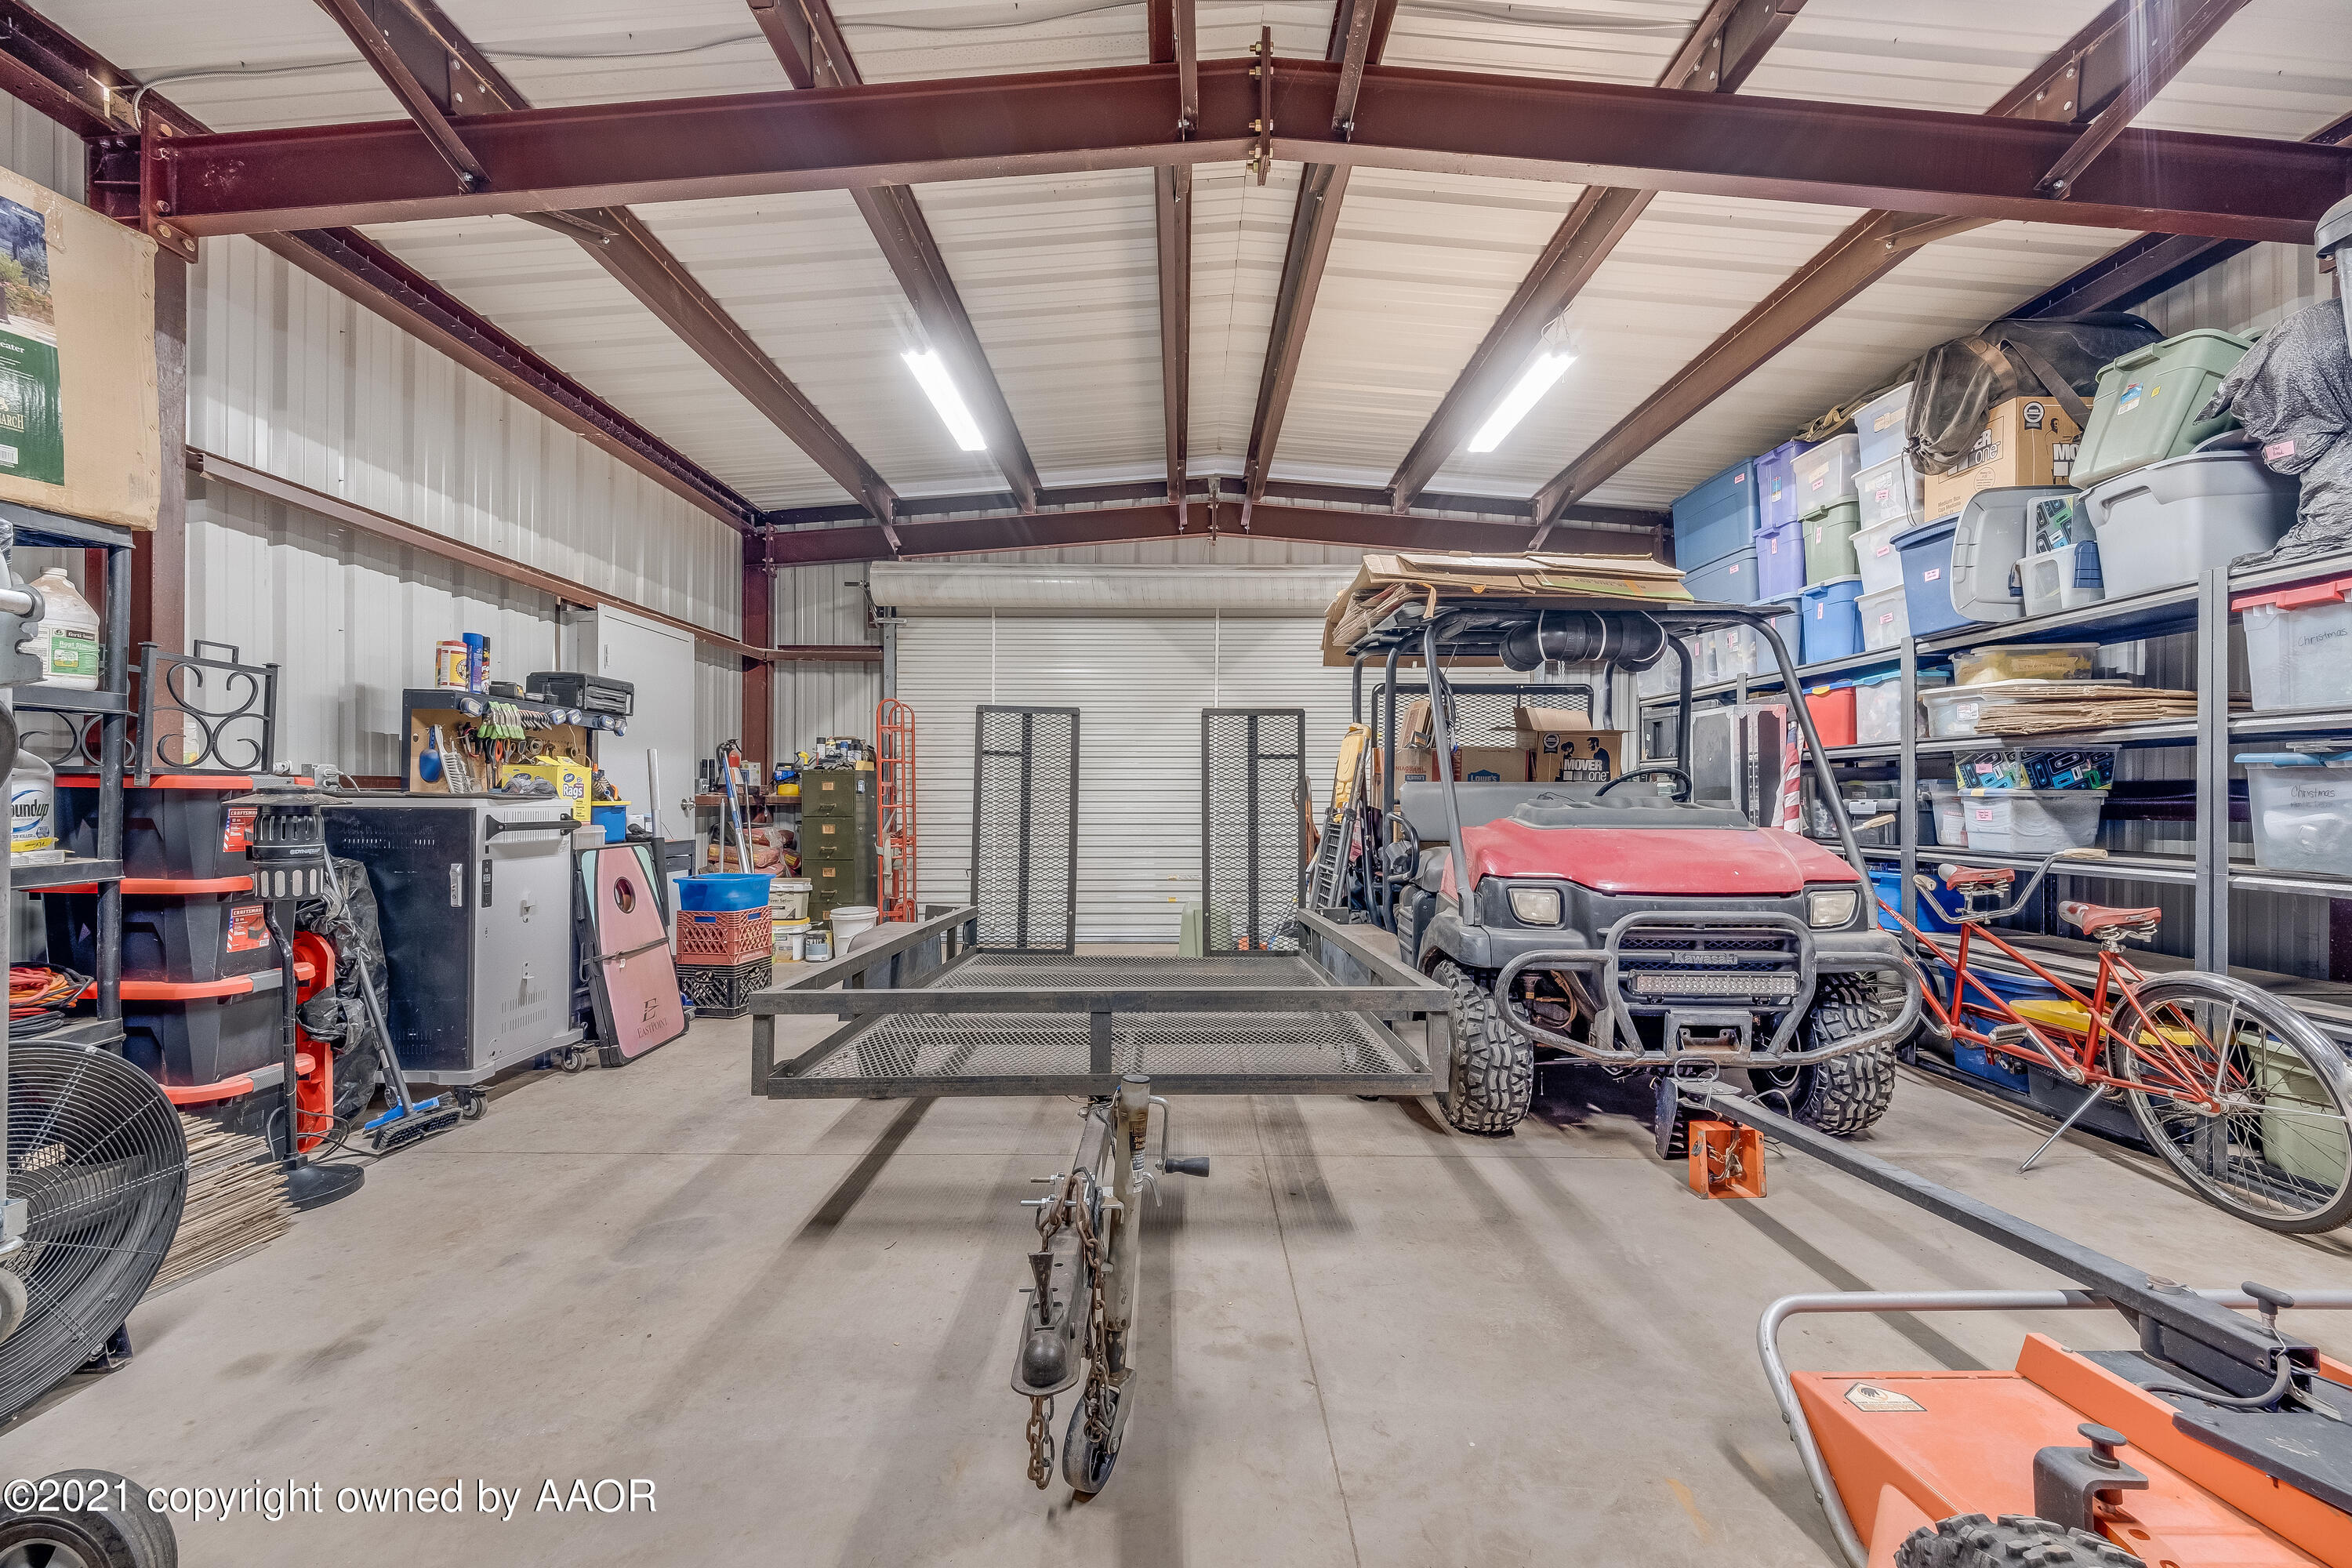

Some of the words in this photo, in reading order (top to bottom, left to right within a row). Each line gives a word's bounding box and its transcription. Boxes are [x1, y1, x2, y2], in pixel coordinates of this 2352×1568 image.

[0, 341, 25, 353] eater
[1975, 444, 1998, 464] one
[2298, 628, 2347, 647] Christmas
[1563, 759, 1602, 771] MOVER
[1588, 771, 1607, 782] one
[563, 783, 583, 800] Rags
[2291, 785, 2336, 798] Christmas
[1674, 953, 1738, 965] Kawasaki
